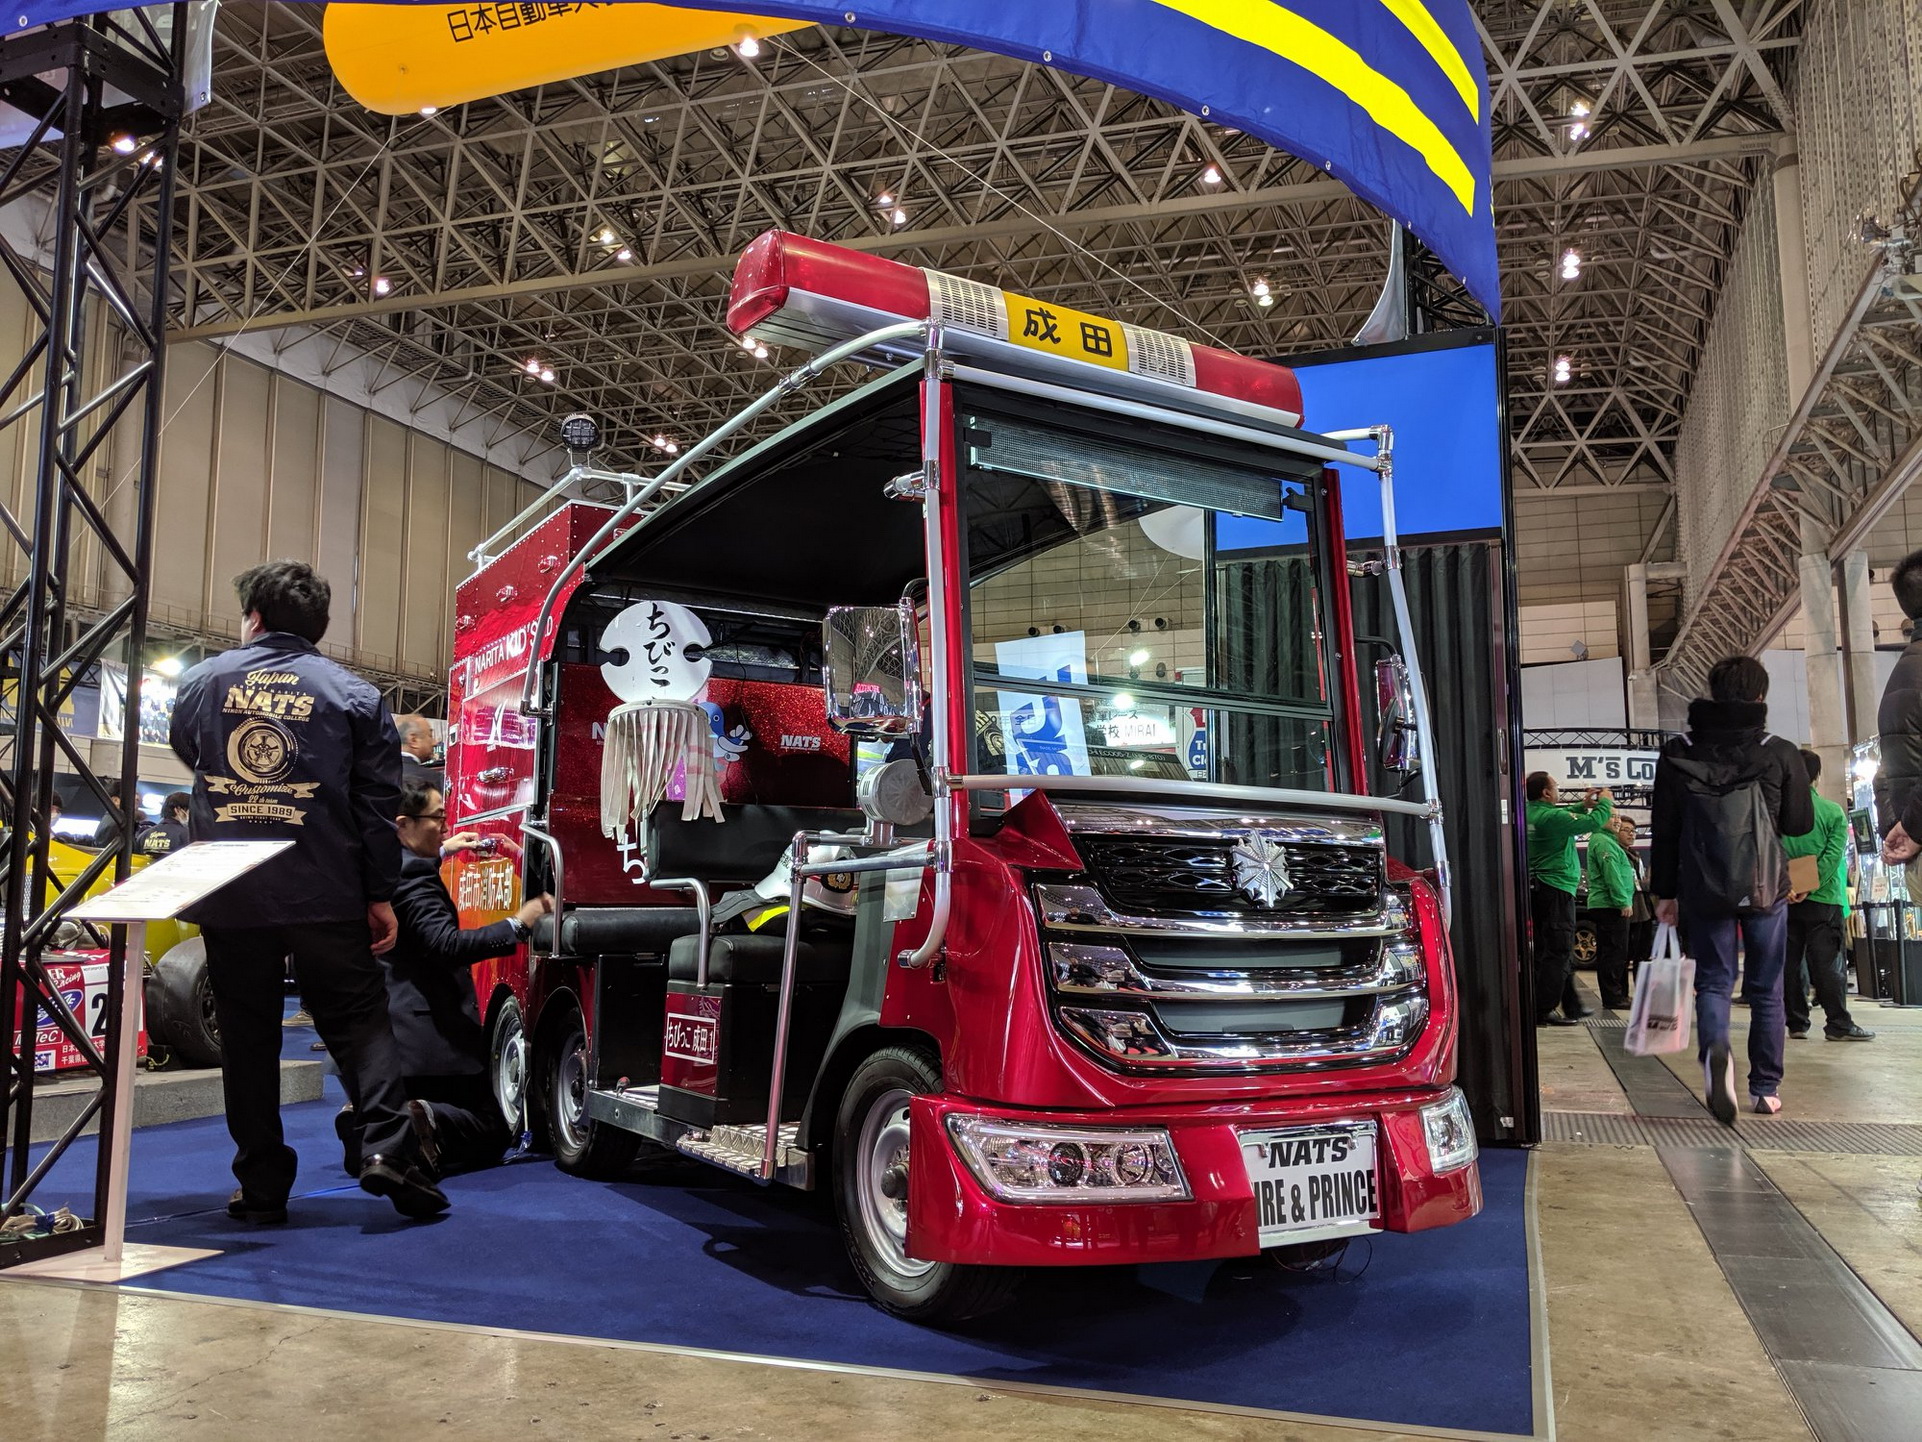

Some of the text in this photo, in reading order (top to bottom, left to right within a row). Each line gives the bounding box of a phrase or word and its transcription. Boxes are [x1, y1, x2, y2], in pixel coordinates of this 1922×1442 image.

[1023, 307, 1112, 357] 成田
[475, 644, 505, 675] NARITA
[245, 668, 300, 688] Japan
[224, 687, 315, 717] NATS
[780, 734, 822, 748] NATS
[230, 805, 293, 817] SINCE 1989
[143, 838, 171, 849] NATS
[1268, 1137, 1349, 1169] NATS
[1253, 1169, 1378, 1228] IRE & PRINCE
